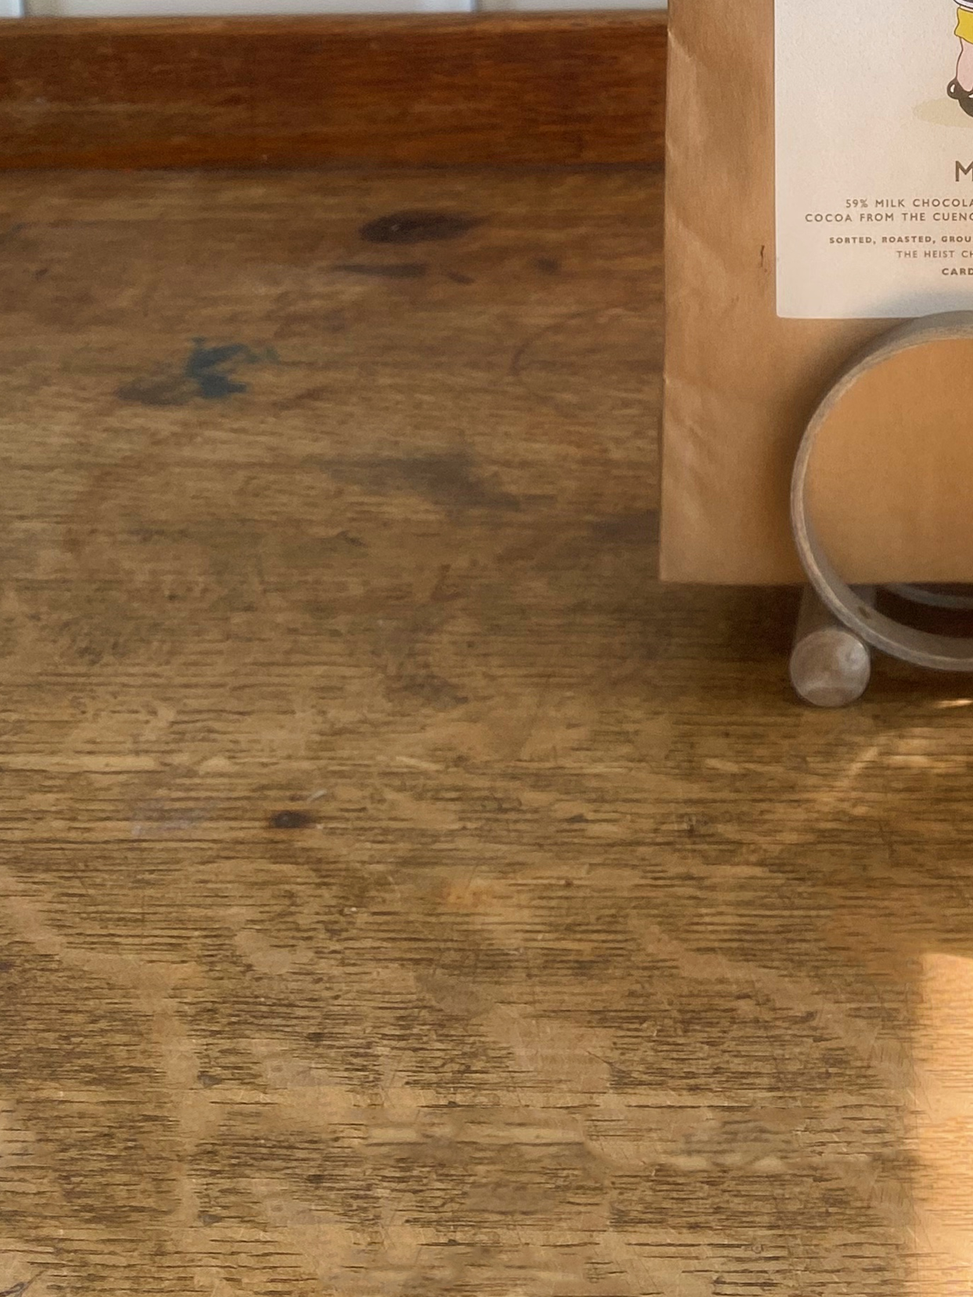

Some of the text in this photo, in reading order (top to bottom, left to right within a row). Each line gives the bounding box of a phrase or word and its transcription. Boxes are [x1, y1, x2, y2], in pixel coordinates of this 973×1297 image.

[846, 199, 868, 208] 59%
[875, 199, 905, 208] MILK
[805, 213, 852, 222] COCOA
[860, 213, 894, 222] FROM
[901, 212, 926, 222] THE
[829, 236, 876, 245] SORTED,
[882, 234, 936, 244] ROASTED,
[896, 250, 917, 258] THE
[924, 249, 955, 258] HEIST
